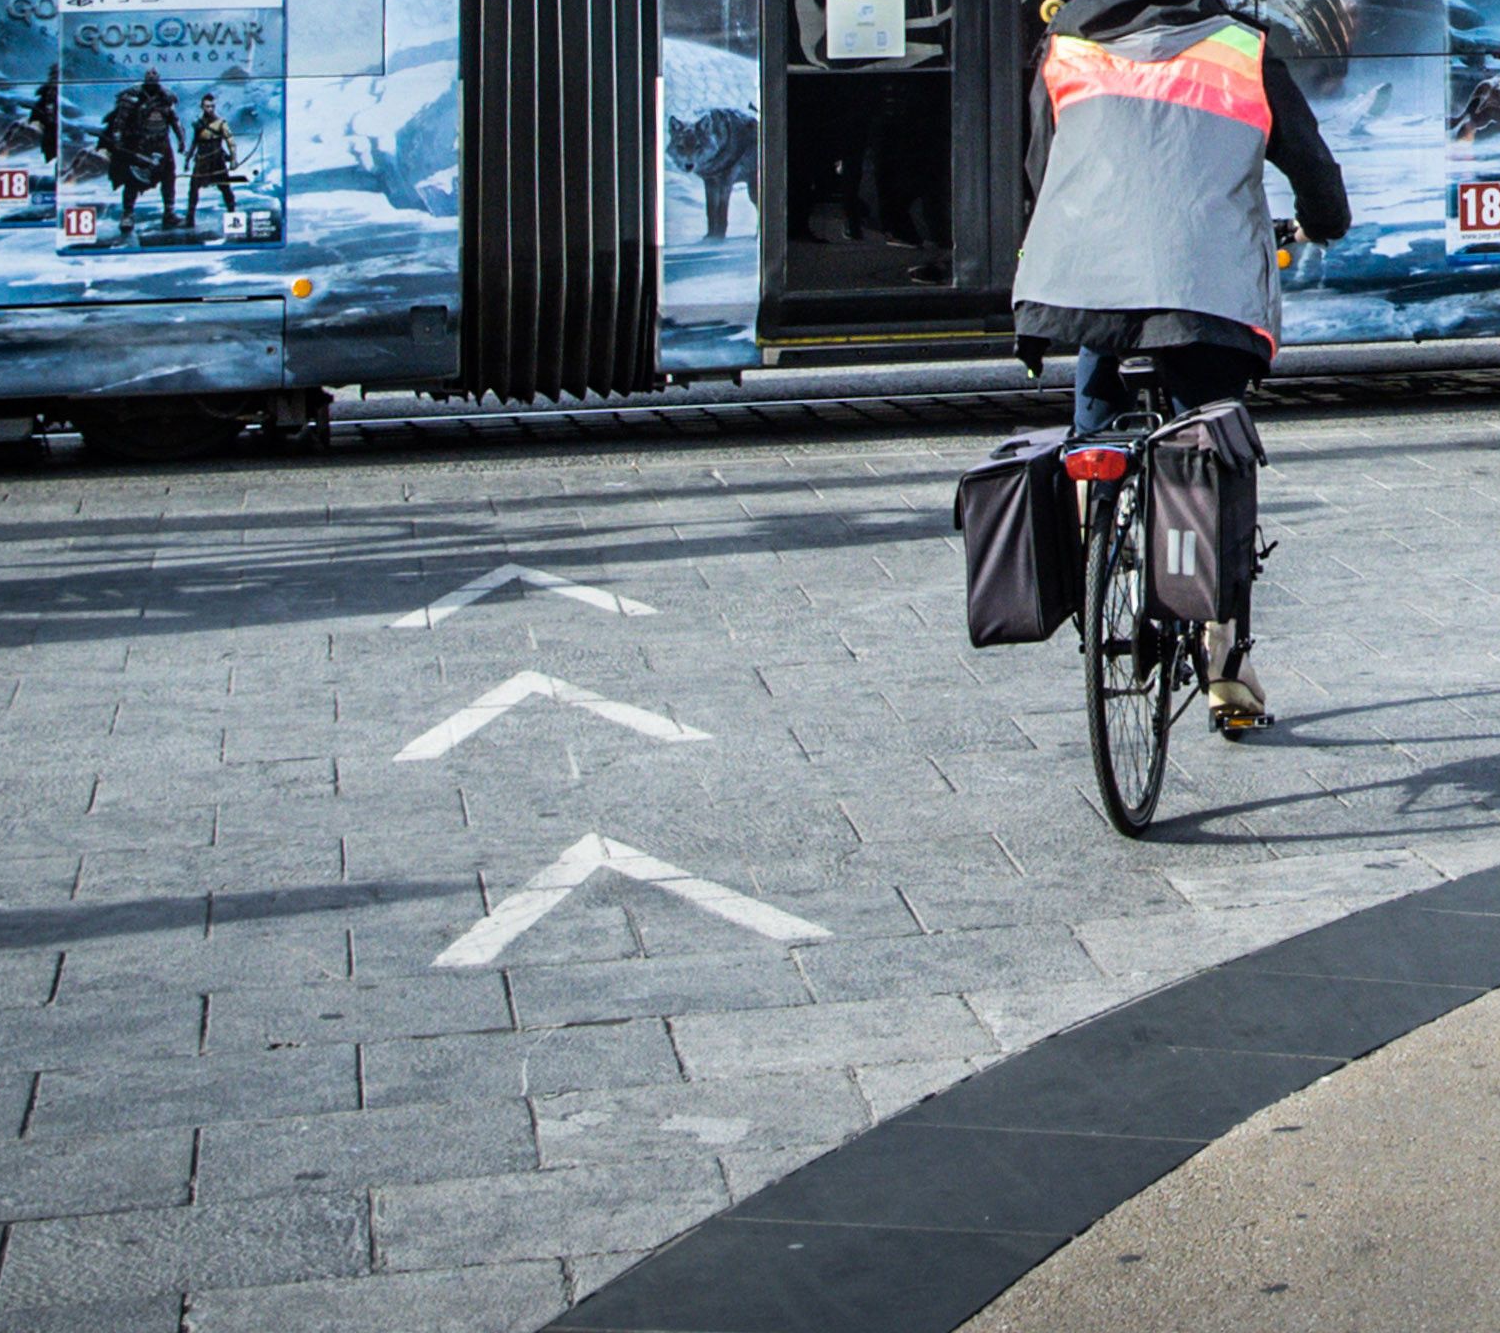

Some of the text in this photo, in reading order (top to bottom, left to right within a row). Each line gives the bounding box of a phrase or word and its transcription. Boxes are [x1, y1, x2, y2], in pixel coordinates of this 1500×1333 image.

[73, 23, 153, 54] GOD
[185, 20, 267, 51] WAR
[0, 172, 27, 198] 18
[67, 210, 94, 235] 18
